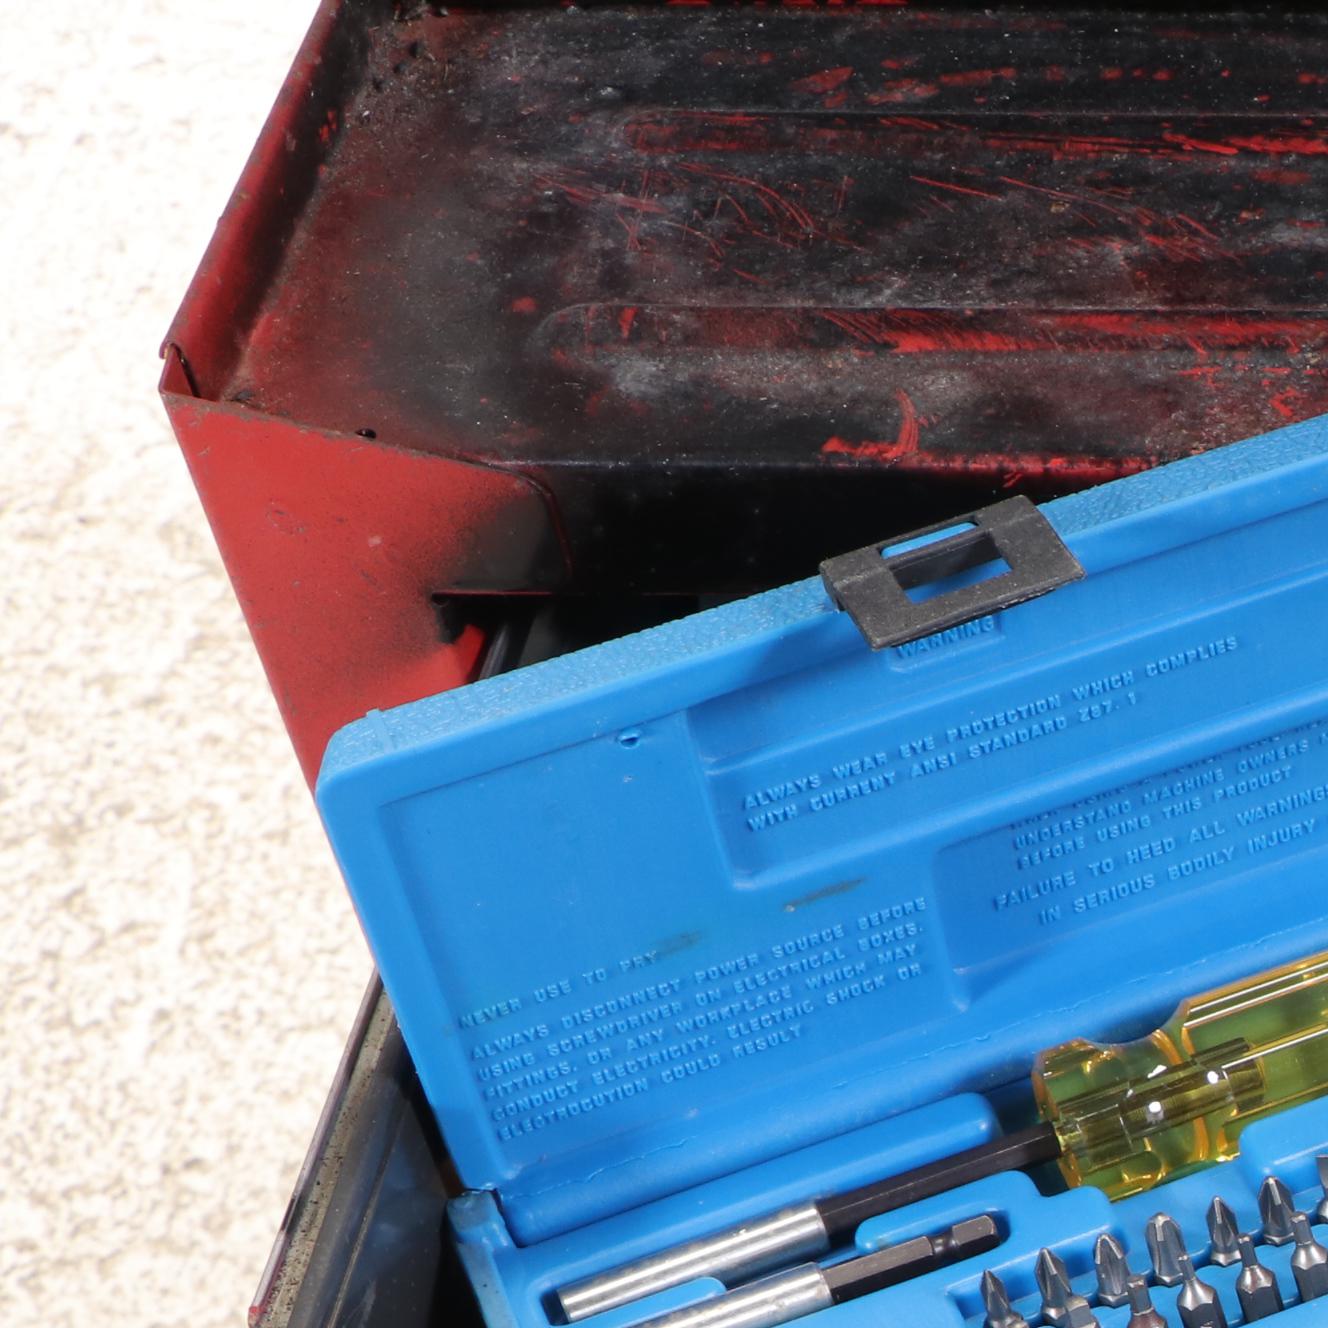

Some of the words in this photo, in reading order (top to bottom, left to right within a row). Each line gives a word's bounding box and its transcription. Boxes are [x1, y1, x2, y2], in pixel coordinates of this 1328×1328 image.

[897, 615, 995, 658] WARNING
[744, 774, 822, 810] ALWAYS
[832, 752, 887, 779] WEAR
[900, 736, 935, 760] EYE
[946, 694, 1060, 742] PROTECTION
[1072, 670, 1135, 701] WHICH
[1145, 636, 1238, 677] COMPLIES
[747, 804, 798, 832] WITH
[810, 771, 896, 811] CURRENT
[911, 752, 957, 778] ANSI
[969, 716, 1067, 759] STANDARD
[1013, 800, 1132, 850] UNDERSTAND
[1142, 768, 1225, 805] MACHINE
[1237, 740, 1308, 773] OWNERS
[1017, 836, 1086, 870] BEFORE
[1096, 815, 1151, 842] USING
[1162, 796, 1202, 820] THIS
[1214, 765, 1292, 804] PRODUCT
[993, 871, 1076, 911] FAILURE
[1088, 857, 1115, 877] TO
[1125, 837, 1176, 865] HEED
[1189, 820, 1226, 844] ALL
[1038, 904, 1062, 926] IN
[1073, 873, 1155, 914] SERIOUS
[1167, 845, 1235, 881] BODILY
[1248, 818, 1316, 853] INJURY
[458, 998, 522, 1029] NEVER
[534, 980, 572, 1003] USE
[582, 968, 607, 985] TO
[471, 1024, 549, 1060] ALWAYS
[561, 979, 681, 1030] DISCONNECT
[695, 953, 759, 985] POWER
[772, 924, 845, 958] SOURCE
[858, 897, 927, 930] BEFORE
[477, 1053, 536, 1082] USING
[546, 1001, 683, 1057] SCREWDRIVER
[696, 988, 721, 1007] ON
[734, 947, 846, 994] ELECTRICAL
[586, 1047, 613, 1065] OR
[626, 1028, 664, 1052] ANY
[675, 985, 793, 1034] WORKPLACE
[805, 962, 866, 990] WHICH
[878, 943, 917, 967] MAY
[491, 1080, 579, 1122] CONDUCT
[727, 1000, 814, 1040] ELECTRIC
[826, 975, 885, 1005] SHOCK
[898, 963, 922, 981] OR
[500, 1078, 649, 1142] ELECTROCUTION
[660, 1054, 720, 1084] COULD
[732, 1025, 802, 1059] RESULT
